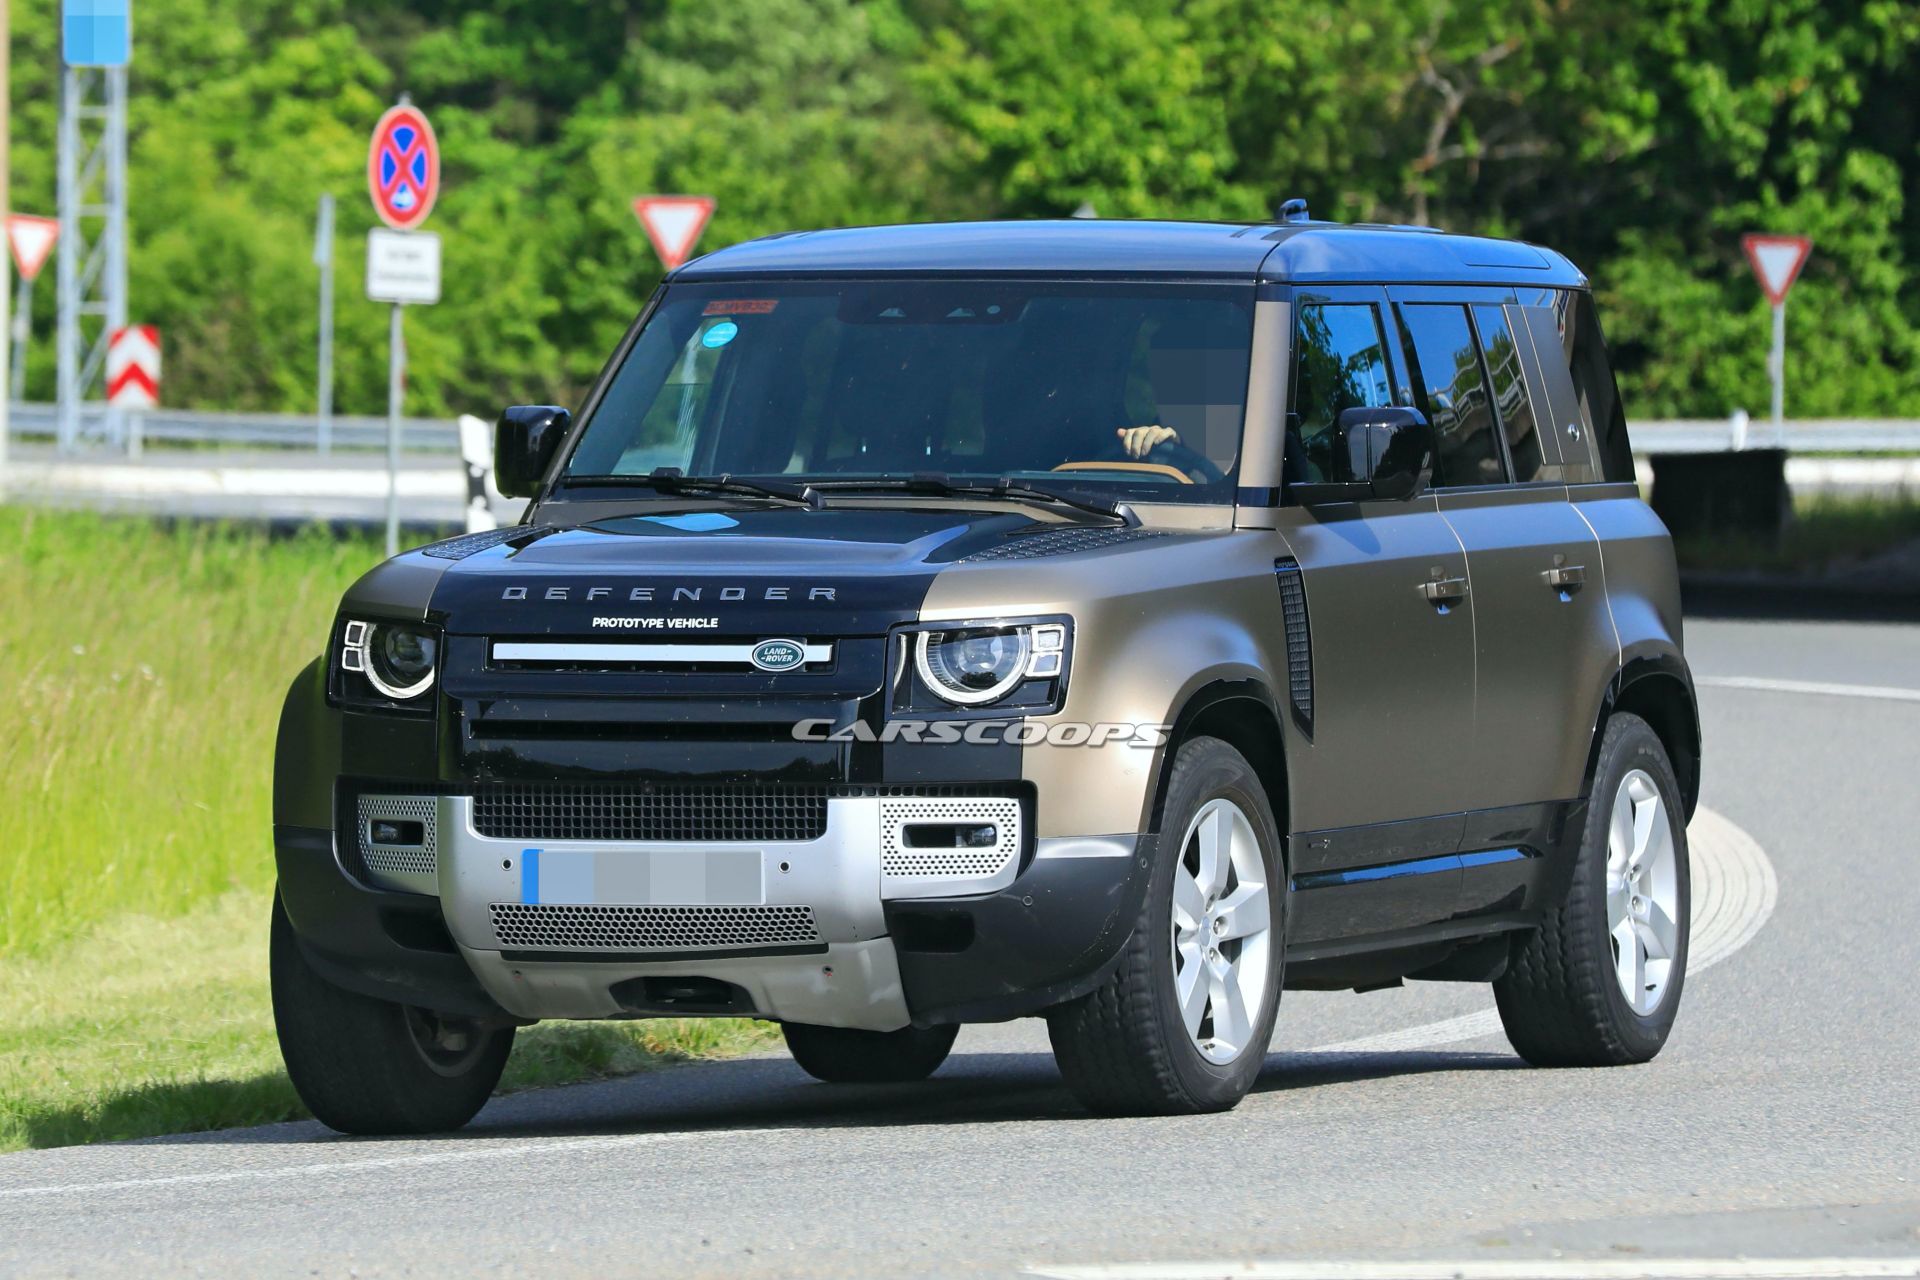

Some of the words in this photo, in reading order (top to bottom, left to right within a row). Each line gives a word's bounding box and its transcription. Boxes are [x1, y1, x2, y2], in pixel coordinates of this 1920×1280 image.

[501, 586, 837, 602] DEFENDER
[592, 617, 665, 629] PROTOTYPE
[666, 617, 719, 629] VEHICLE
